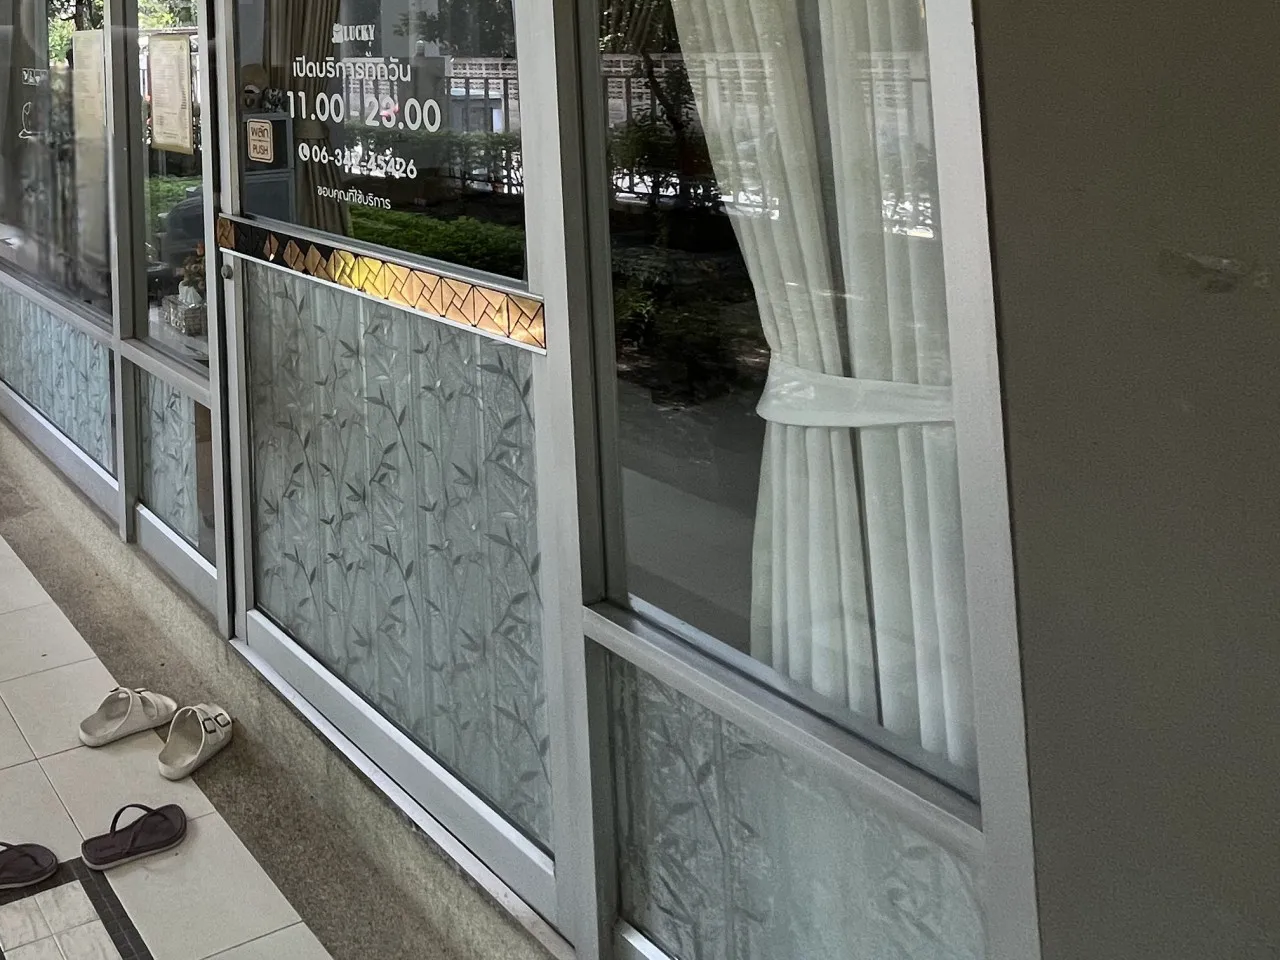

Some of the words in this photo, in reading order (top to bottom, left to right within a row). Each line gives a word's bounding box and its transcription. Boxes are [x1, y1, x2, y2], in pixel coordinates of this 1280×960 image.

[342, 24, 376, 41] LUCKY
[286, 90, 345, 123] 11.00
[252, 143, 269, 155] PUSH
[317, 185, 391, 210] ขอบคุณที่ใช้บริการ
